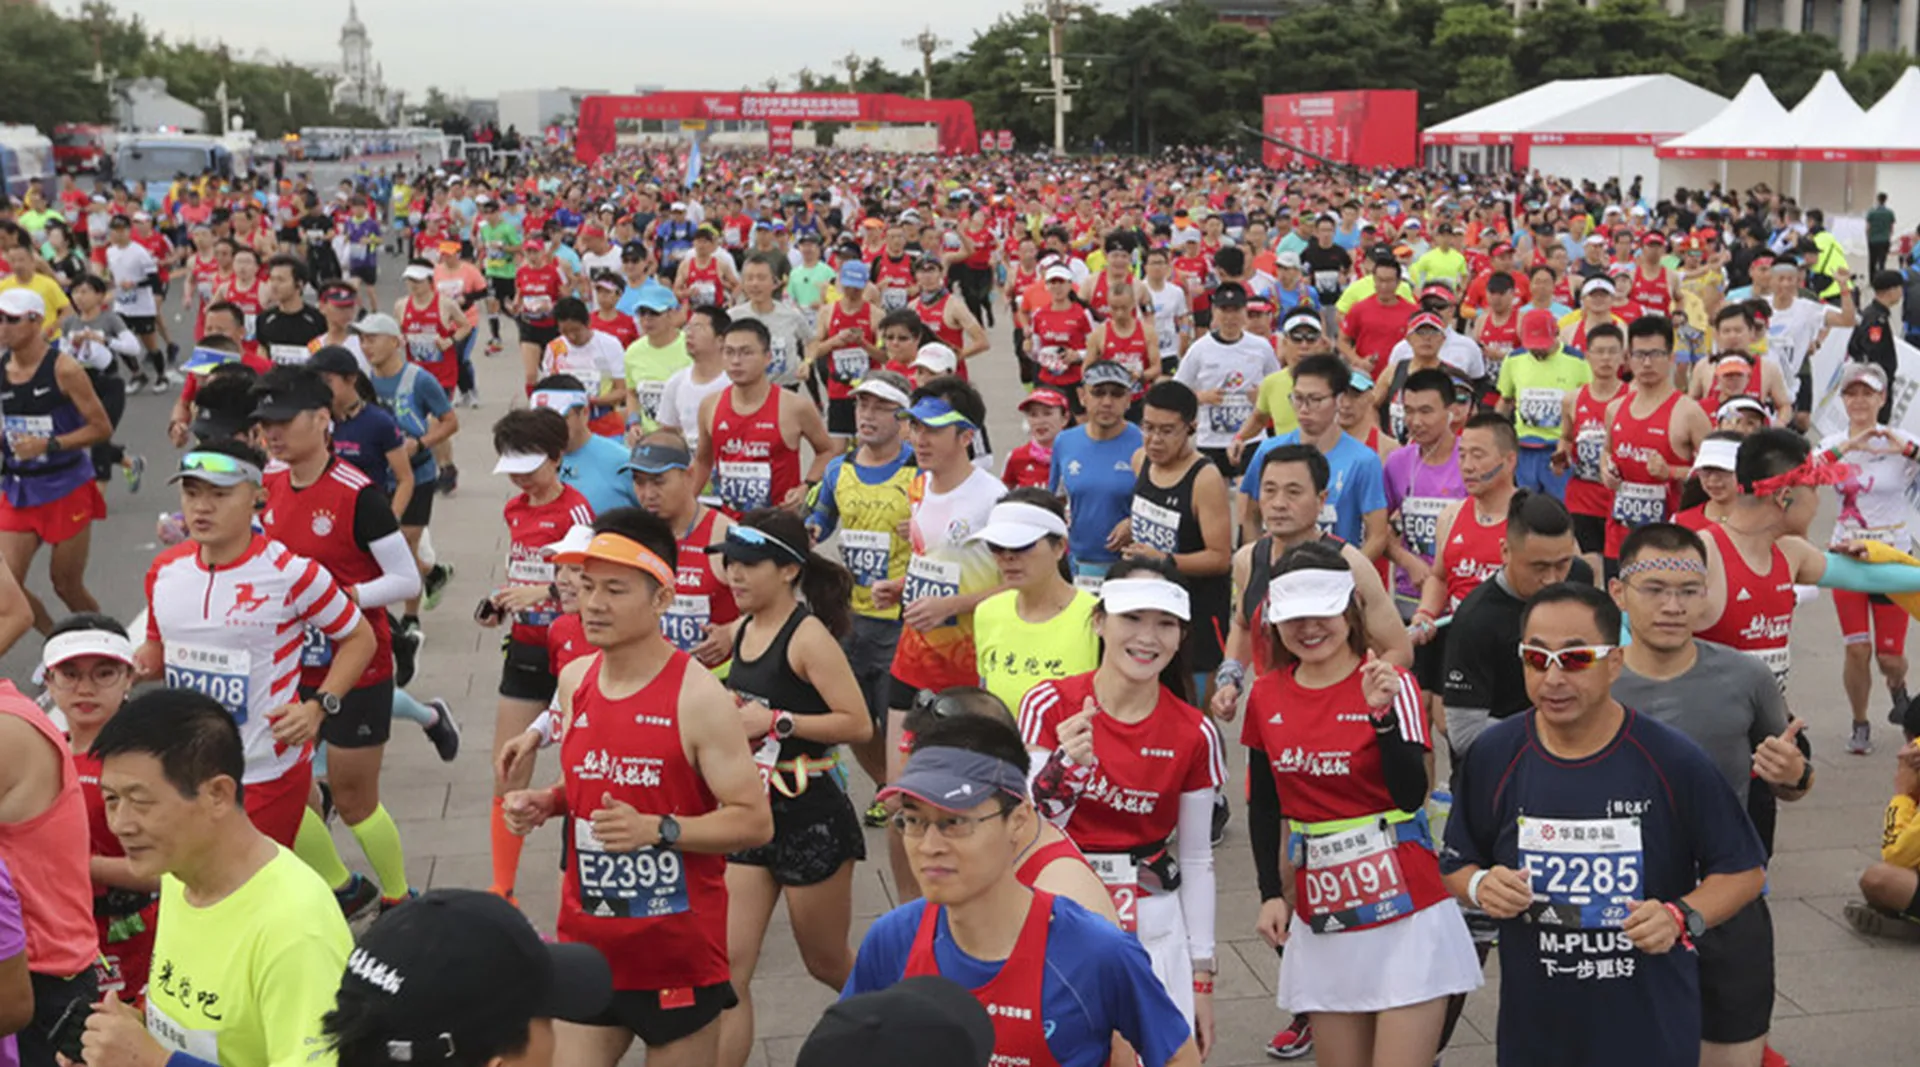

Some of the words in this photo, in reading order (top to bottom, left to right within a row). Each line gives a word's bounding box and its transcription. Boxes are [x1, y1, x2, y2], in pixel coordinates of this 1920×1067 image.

[846, 499, 897, 513] ANTA
[1319, 833, 1368, 857] 华夏幸福
[1558, 824, 1616, 842] 华夏幸福
[578, 851, 681, 889] E2399
[1305, 852, 1398, 906] D9191
[1524, 855, 1639, 894] F2285
[1539, 931, 1634, 954] M-PLUS
[1541, 956, 1635, 980] 下一步更好
